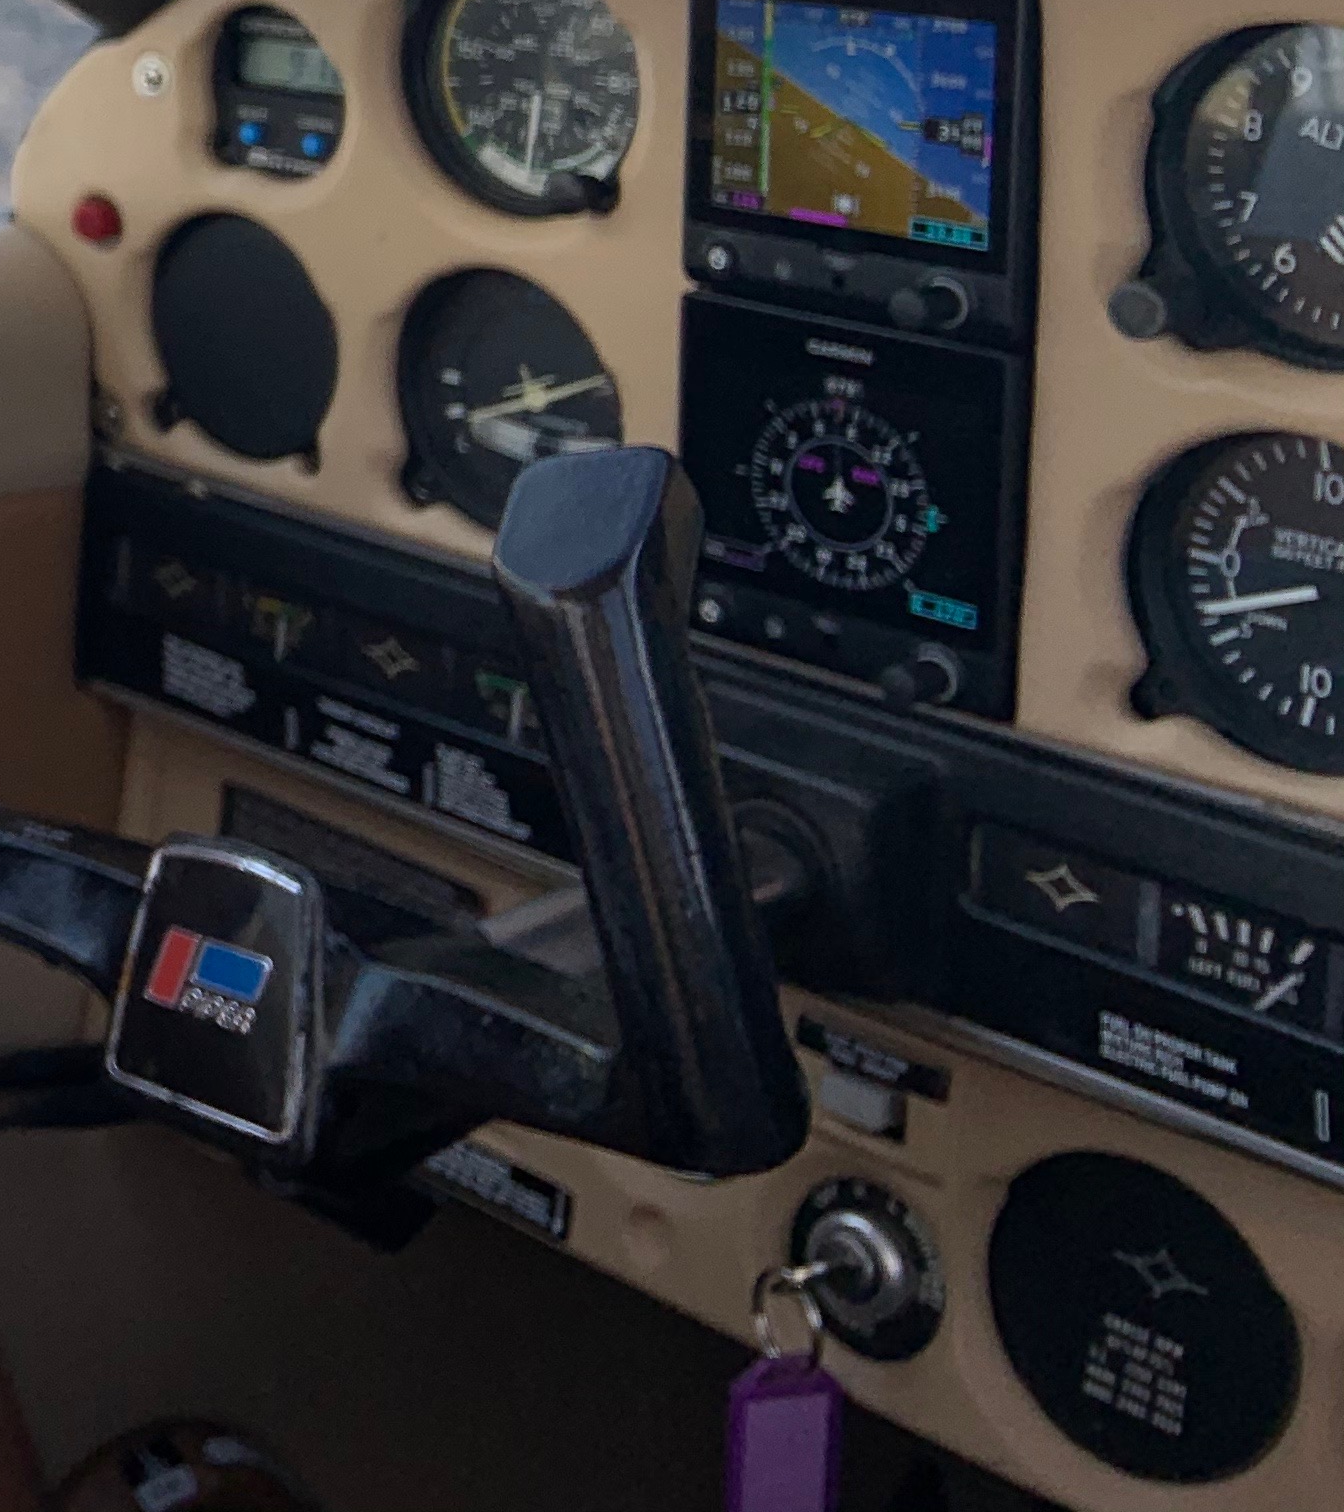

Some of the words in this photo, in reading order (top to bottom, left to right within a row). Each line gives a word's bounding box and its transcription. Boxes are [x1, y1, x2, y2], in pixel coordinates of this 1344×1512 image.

[1290, 66, 1313, 98] 9
[1243, 108, 1263, 142] 8
[1237, 190, 1259, 223] 7
[1273, 241, 1297, 275] 6
[1299, 663, 1333, 700] 10
